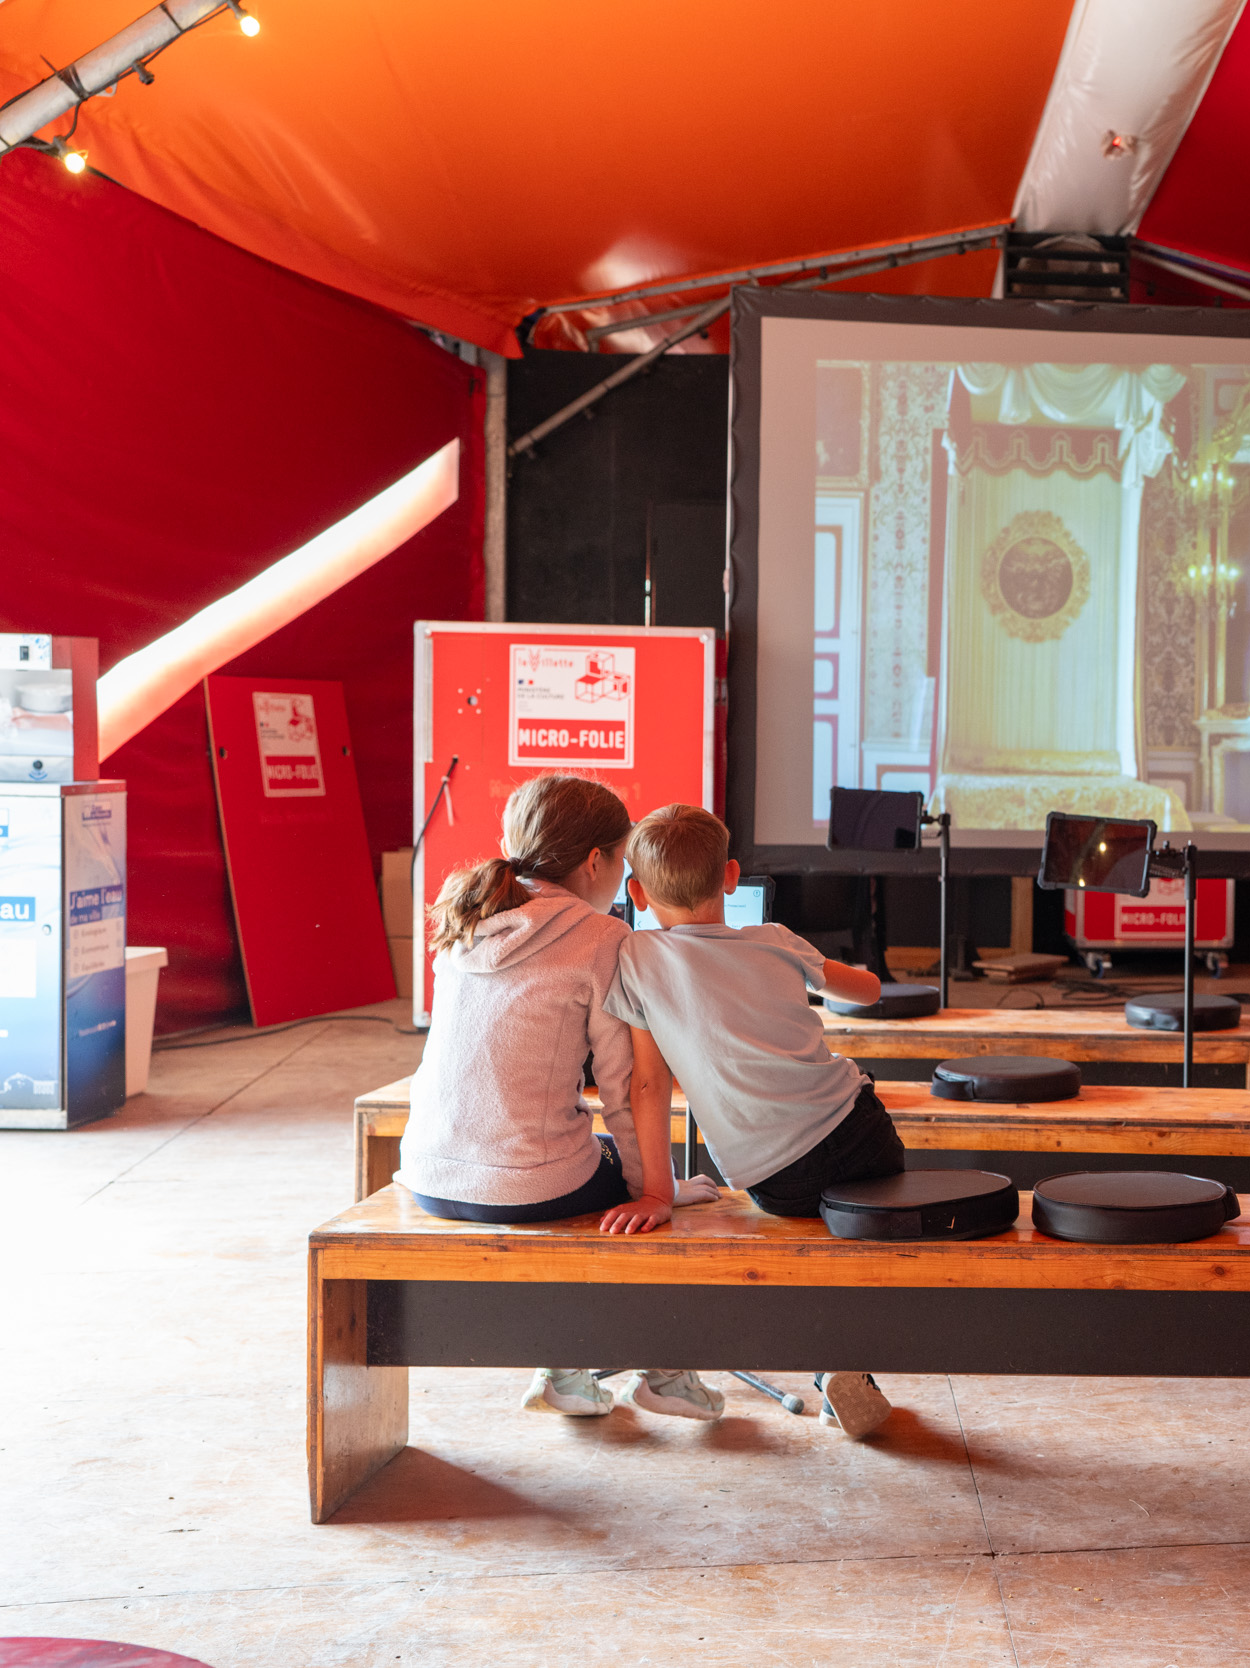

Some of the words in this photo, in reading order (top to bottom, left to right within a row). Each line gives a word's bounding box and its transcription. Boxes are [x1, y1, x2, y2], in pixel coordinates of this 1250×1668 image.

[518, 729, 624, 749] MICRO-FOLIE
[266, 764, 318, 780] MICRO-FOLIE
[0, 903, 29, 919] au
[1121, 912, 1185, 925] MICRO-FOLI
